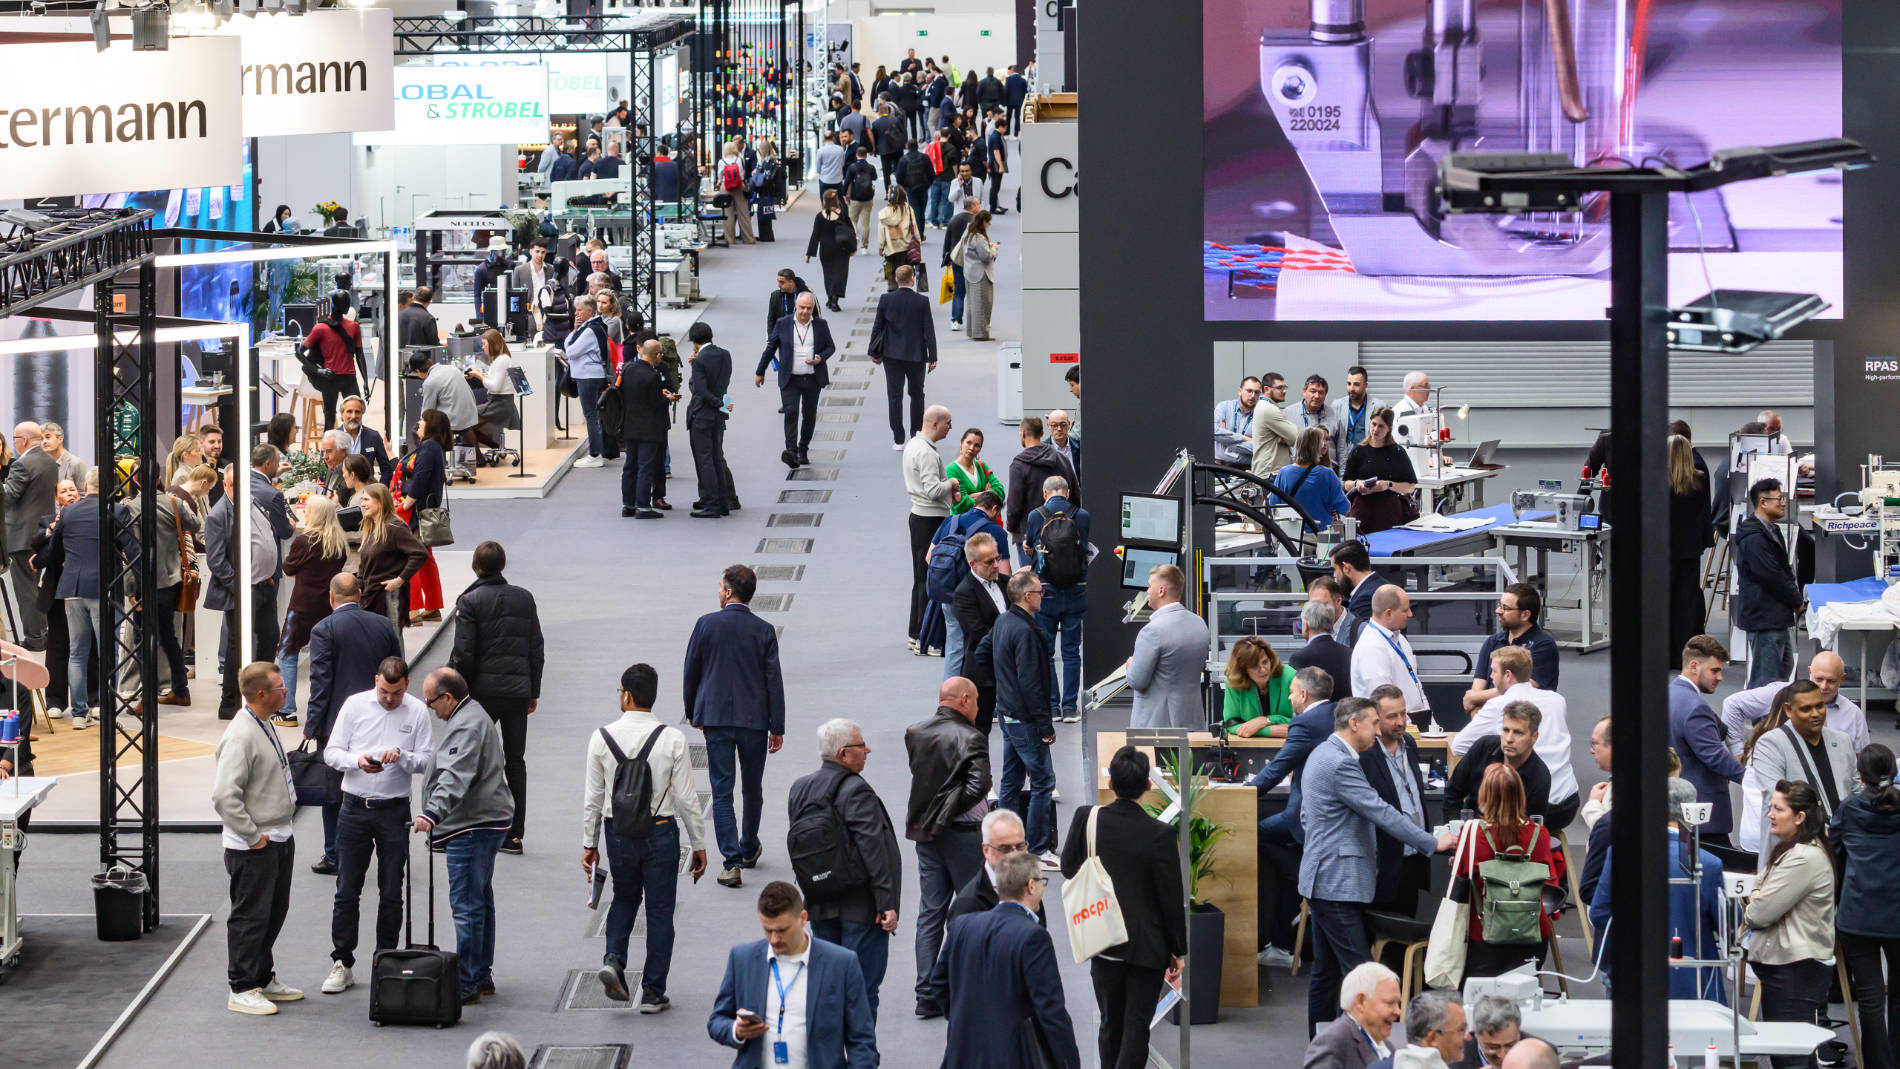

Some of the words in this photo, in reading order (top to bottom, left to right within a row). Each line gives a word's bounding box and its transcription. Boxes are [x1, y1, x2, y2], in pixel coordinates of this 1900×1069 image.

[427, 104, 440, 119] &
[445, 102, 544, 119] STROBEL
[1307, 106, 1341, 118] 0195
[1290, 119, 1341, 131] 220024
[1865, 361, 1898, 371] RPAS
[1828, 521, 1878, 531] Richpeace
[1699, 808, 1706, 821] 6
[1735, 880, 1744, 894] 5
